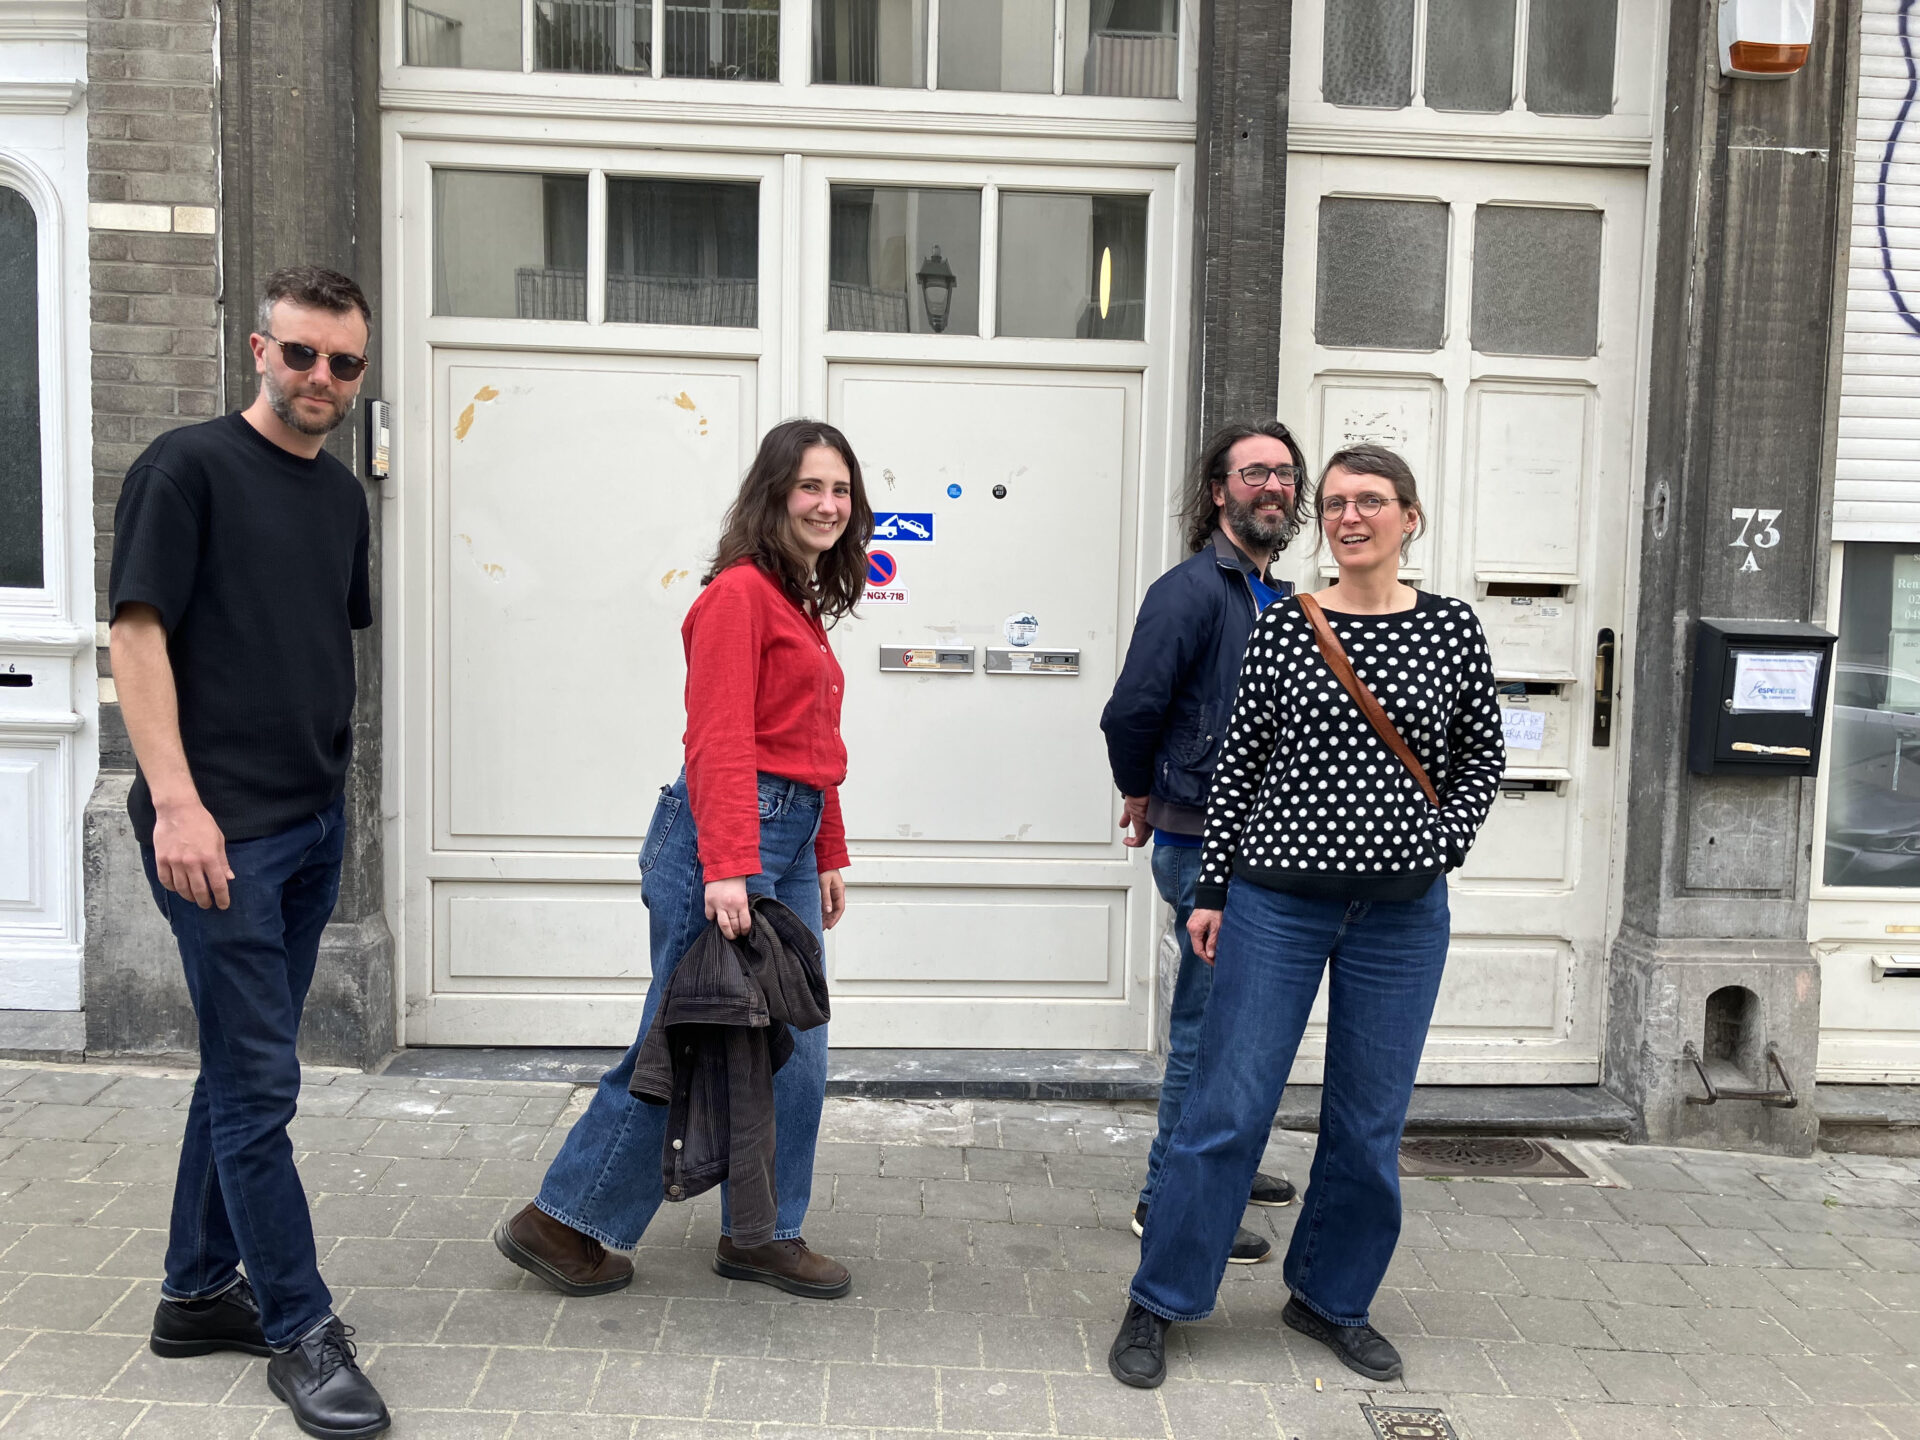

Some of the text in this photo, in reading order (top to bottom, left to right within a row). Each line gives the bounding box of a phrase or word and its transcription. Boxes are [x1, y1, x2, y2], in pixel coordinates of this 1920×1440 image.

[1728, 508, 1783, 549] 73
[1739, 551, 1762, 572] A
[1897, 578, 1920, 589] Ren
[863, 591, 905, 601] -NGX-718
[9, 664, 15, 673] 6
[1503, 712, 1526, 726] UCA
